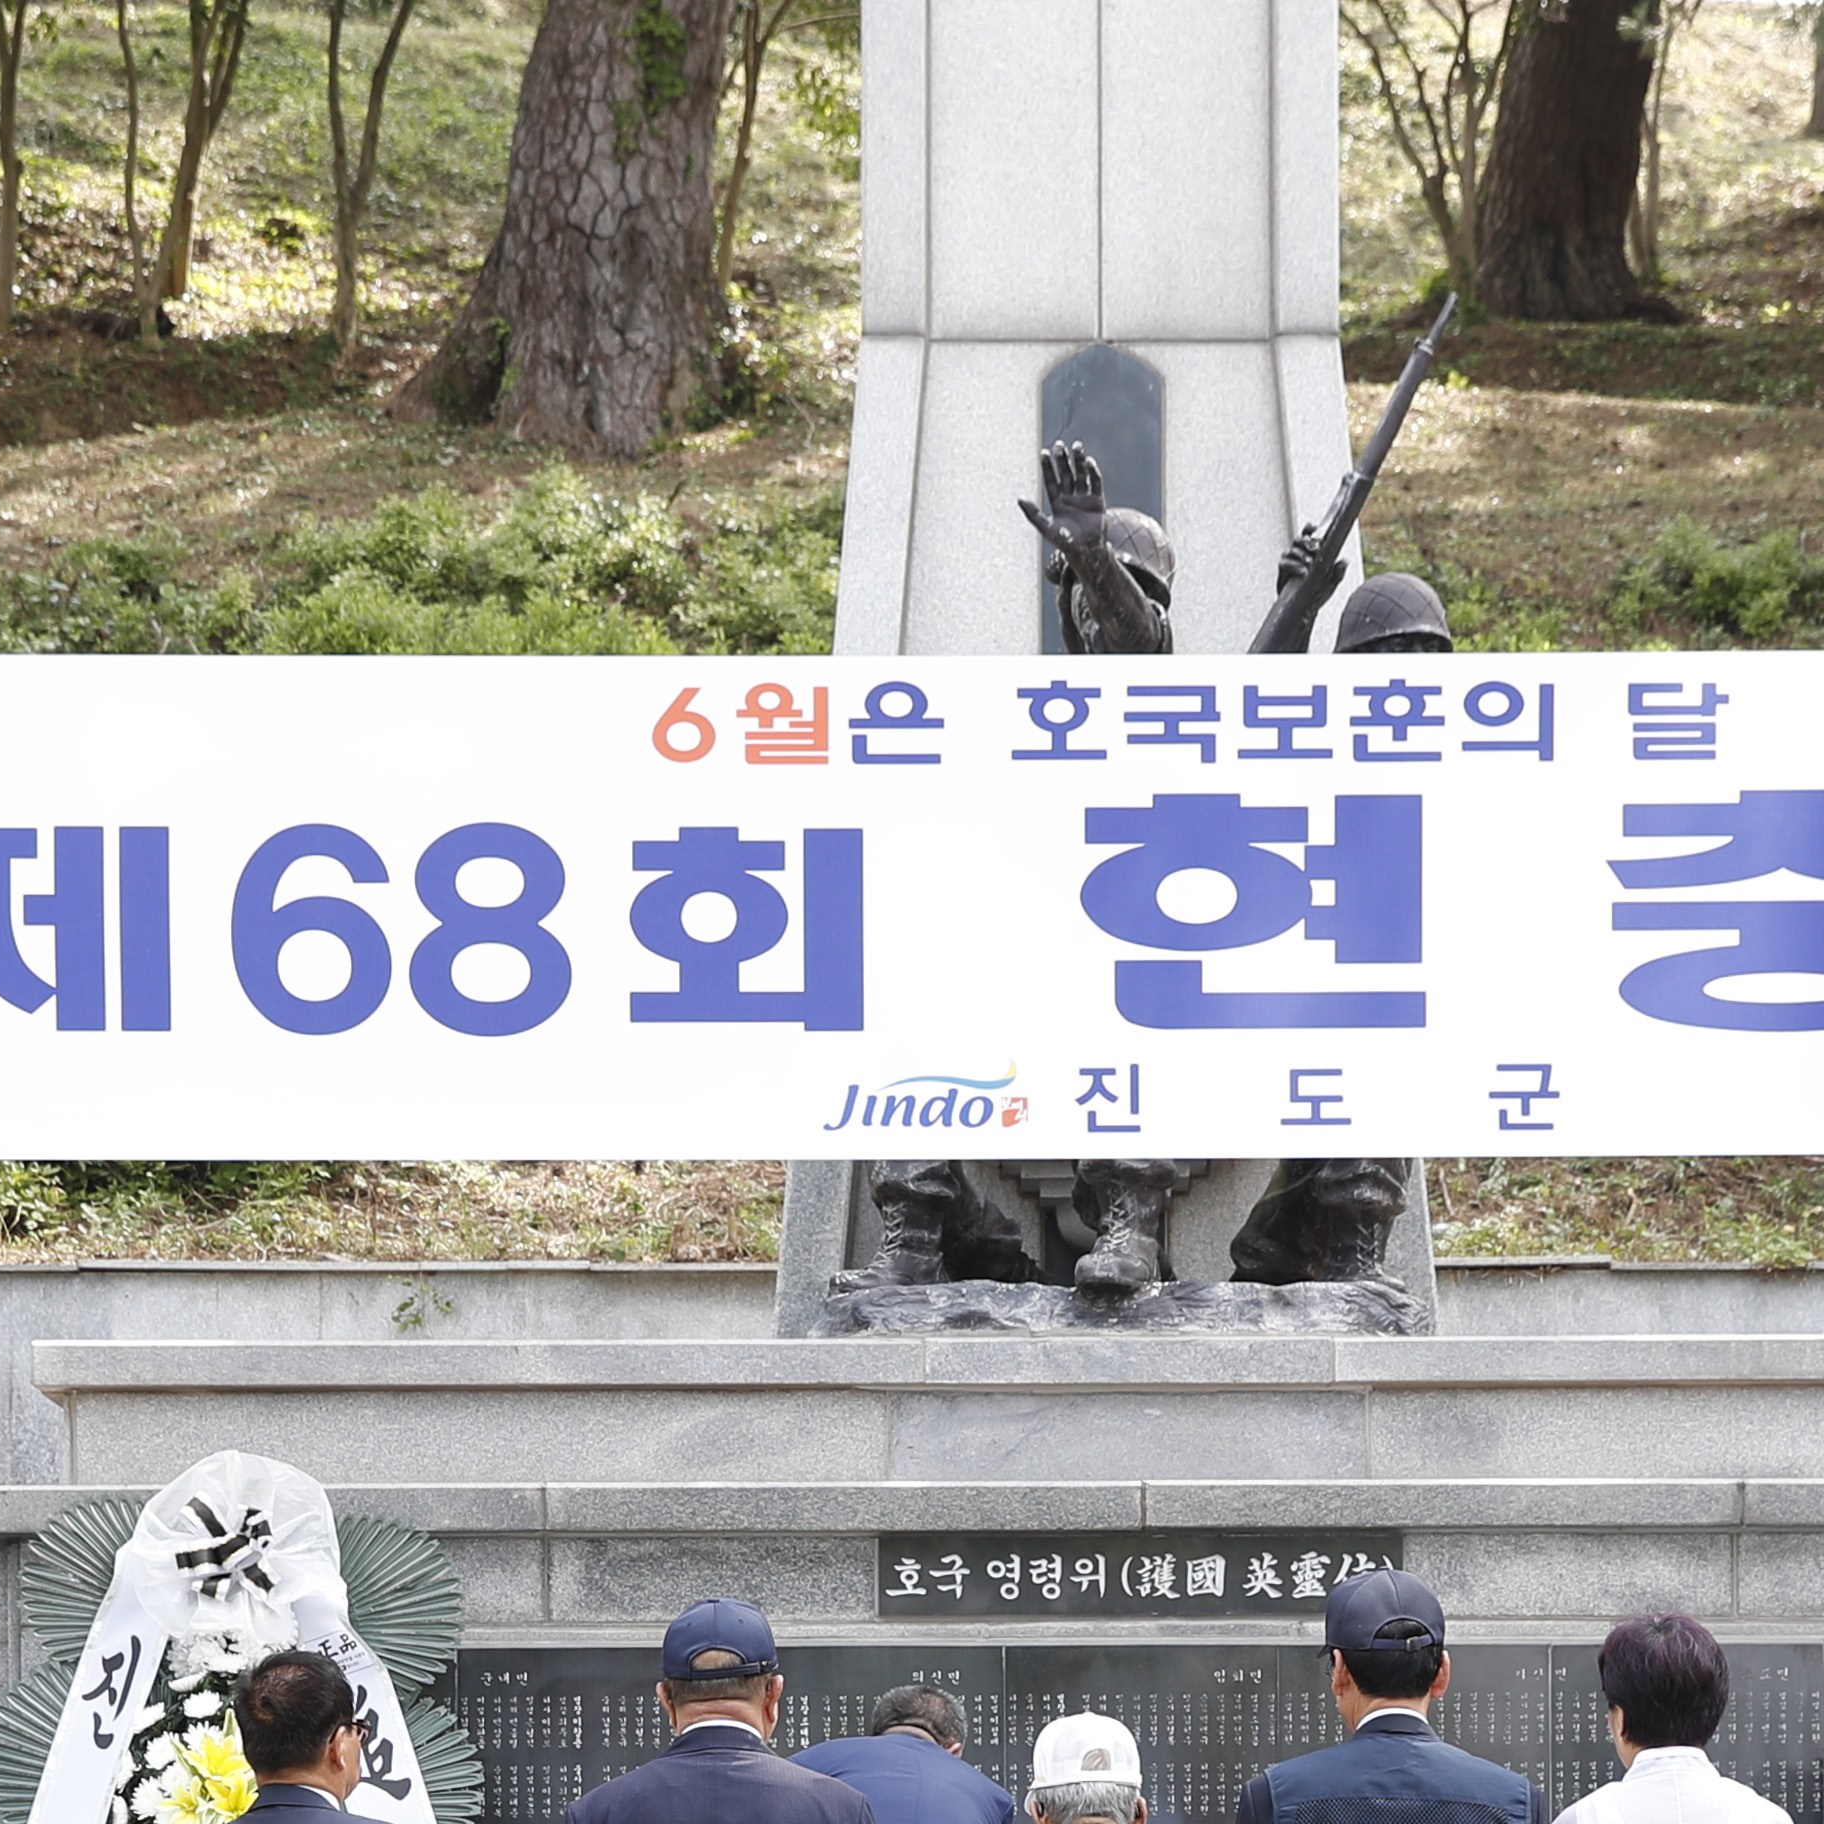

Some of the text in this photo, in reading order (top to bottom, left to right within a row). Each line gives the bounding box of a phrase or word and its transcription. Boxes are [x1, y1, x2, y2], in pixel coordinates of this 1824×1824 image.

[652, 679, 1729, 765] 6월은 호국보훈의 달
[823, 1084, 994, 1131] Jindo
[884, 1554, 972, 1600] 호국
[481, 1671, 528, 1687] 군내면
[911, 1669, 961, 1685] 의신면
